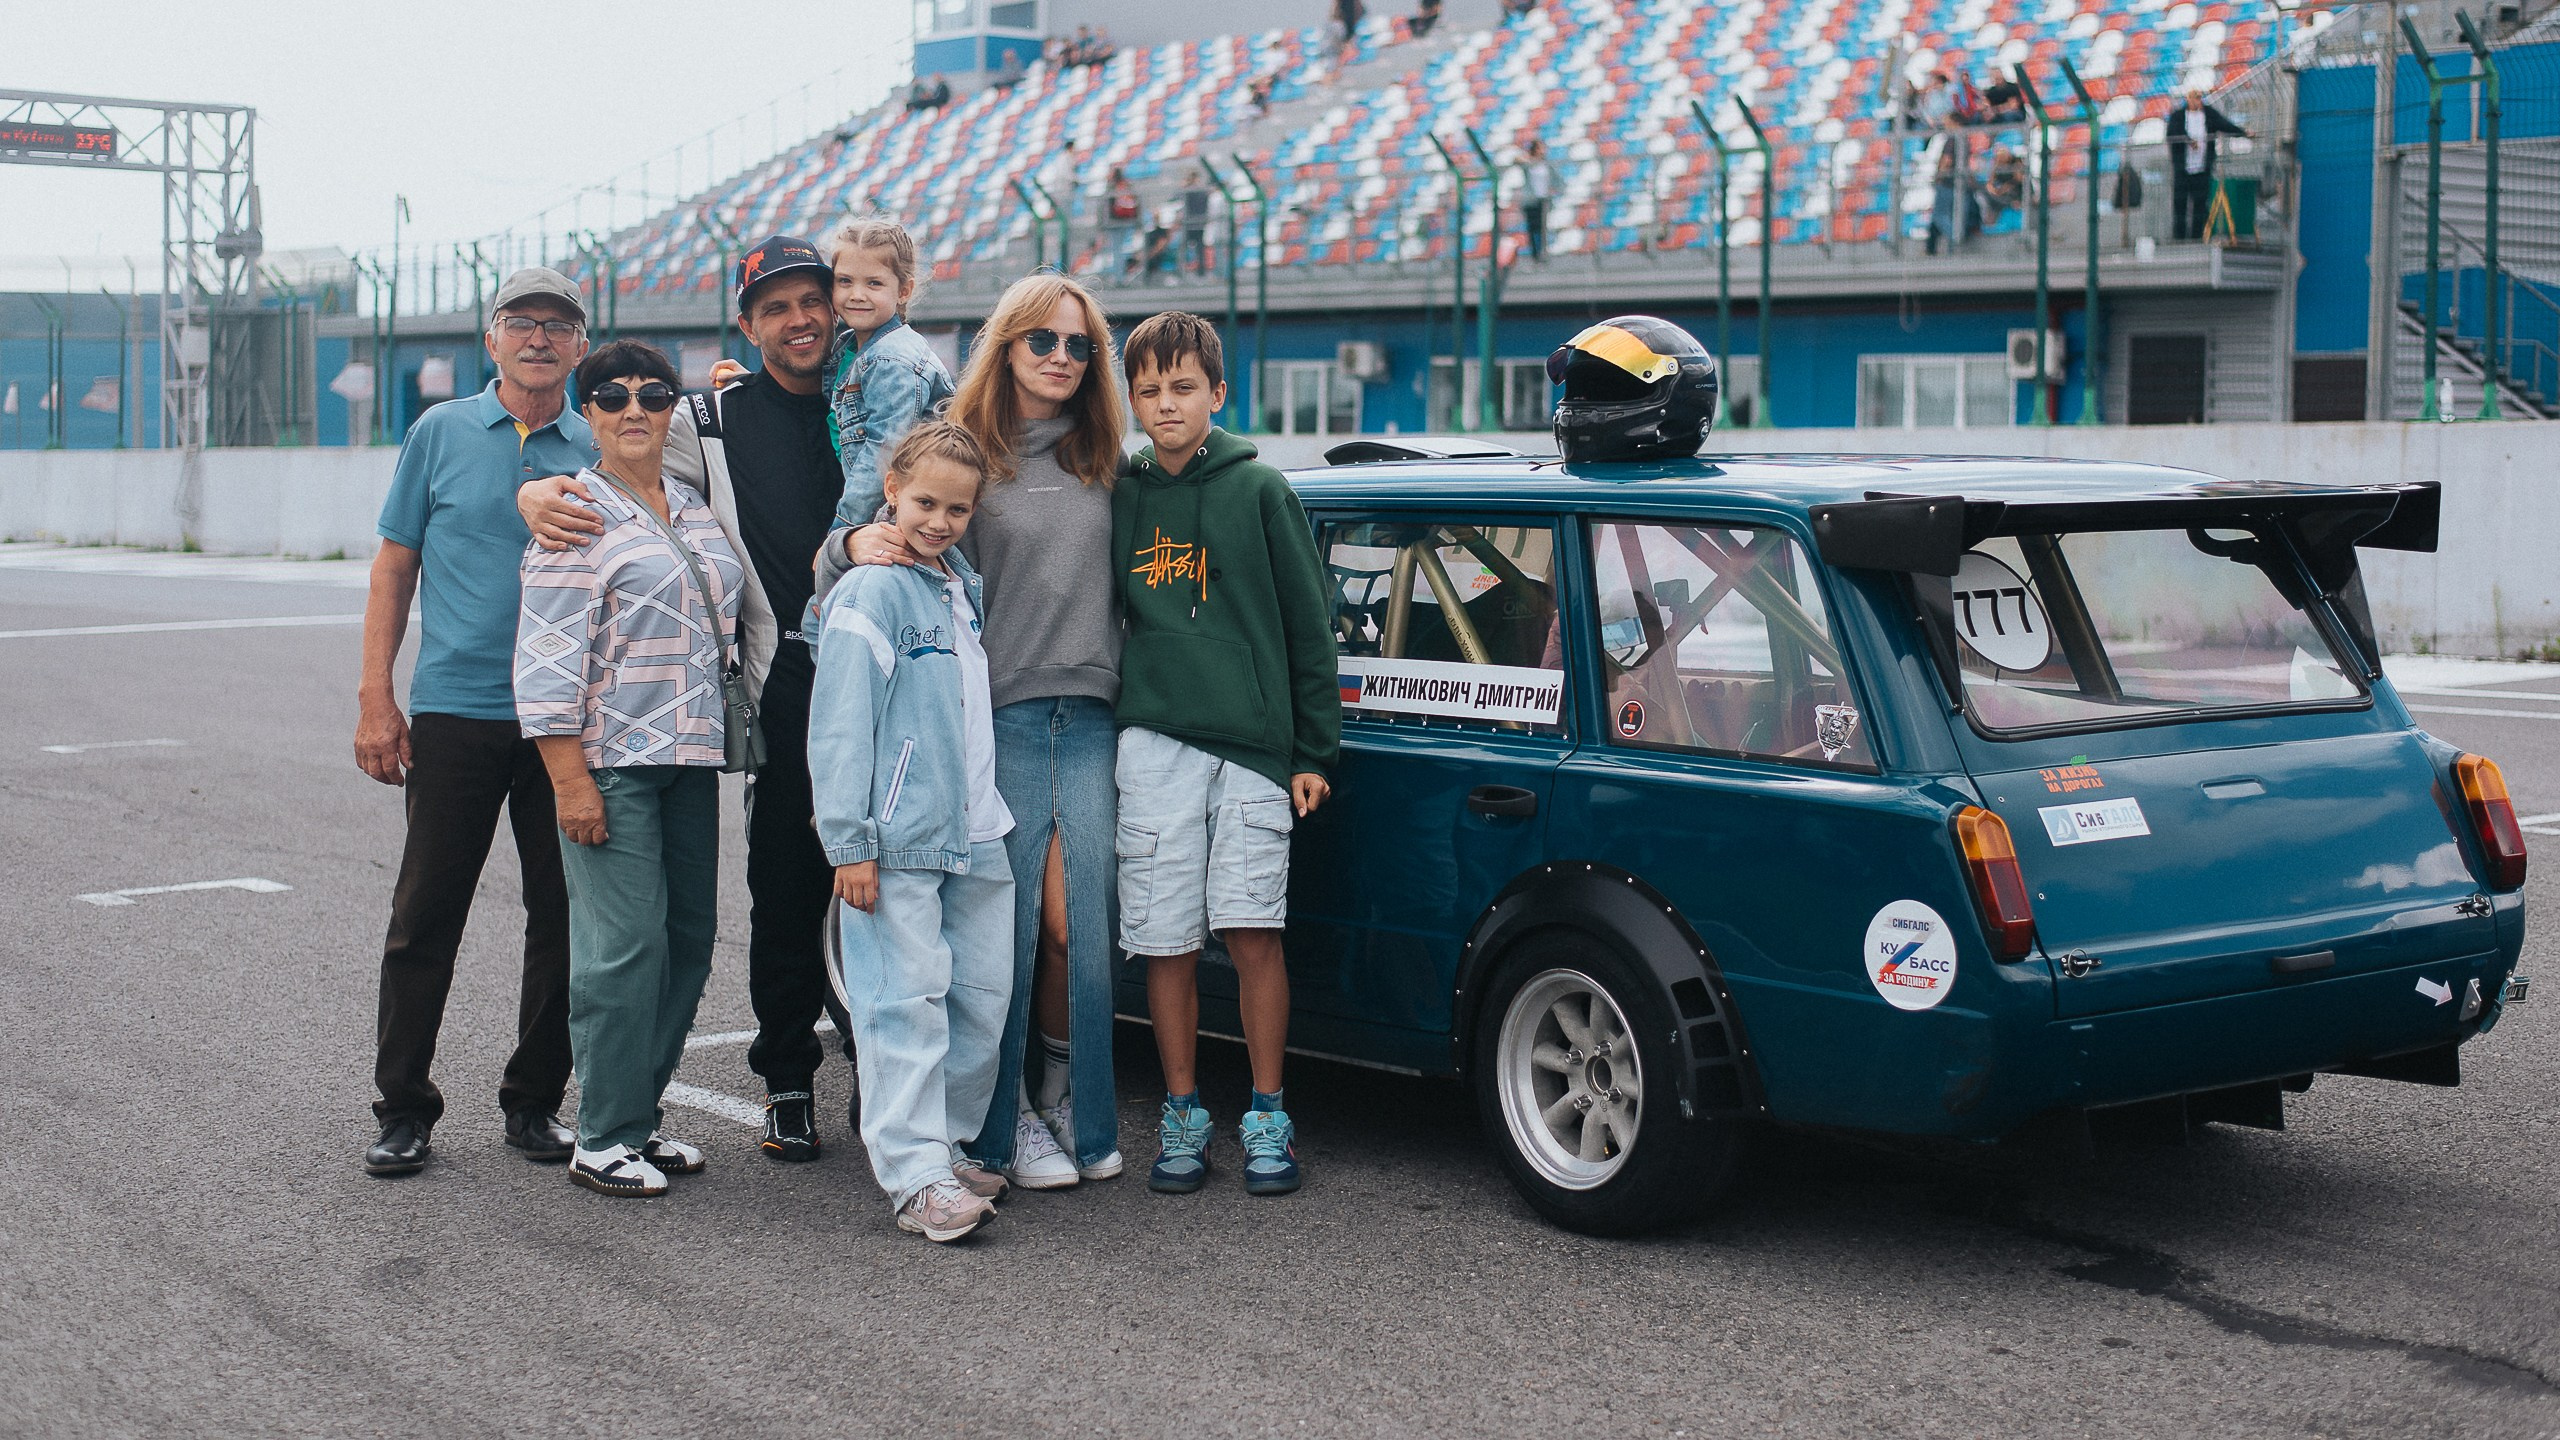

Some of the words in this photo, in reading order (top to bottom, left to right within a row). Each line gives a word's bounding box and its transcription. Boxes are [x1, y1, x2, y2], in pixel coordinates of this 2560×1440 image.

[1953, 587, 2033, 638] 777
[898, 625, 945, 655] Gret
[1363, 674, 1472, 704] ЖИТНИКОВИЧ
[1474, 682, 1559, 712] ДМИТРИЙ
[1627, 711, 1634, 724] 1
[2039, 769, 2058, 782] ЗА
[2055, 765, 2099, 780] ЖИЗНЬ
[2046, 782, 2062, 793] НА
[2061, 778, 2105, 793] ДОРОГАХ
[1892, 918, 1930, 932] СИБГАЛС
[1880, 941, 1899, 955] КУ
[1909, 957, 1950, 973] БАСС
[1883, 972, 1895, 984] ЗА
[1895, 974, 1930, 988] РОДИНУ
